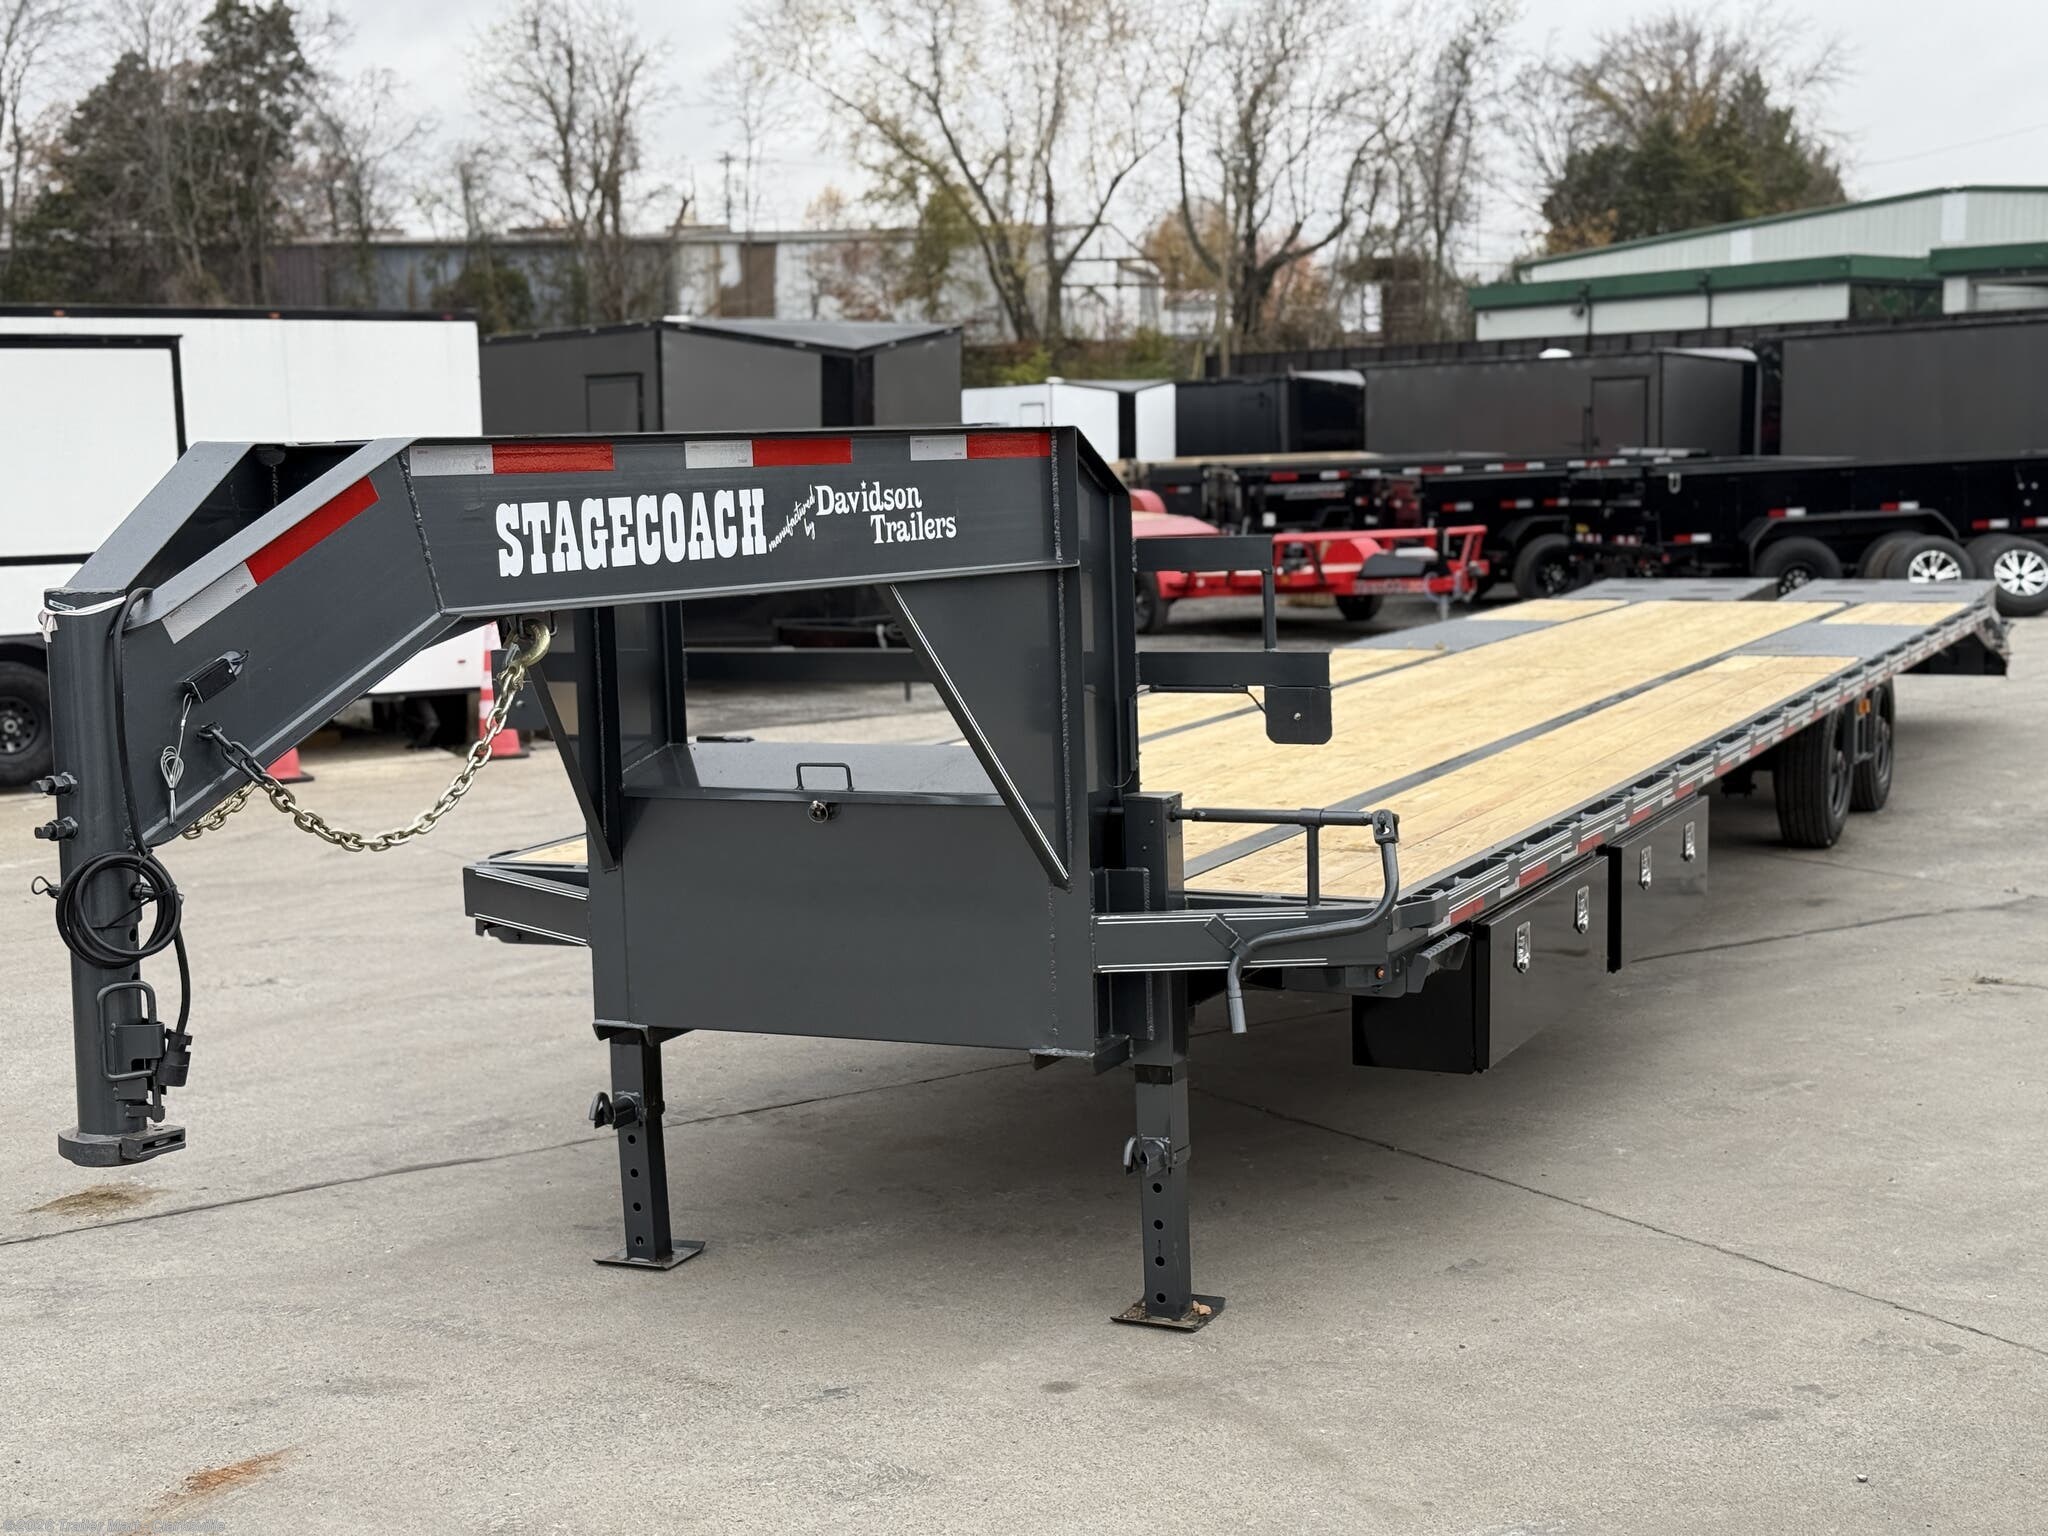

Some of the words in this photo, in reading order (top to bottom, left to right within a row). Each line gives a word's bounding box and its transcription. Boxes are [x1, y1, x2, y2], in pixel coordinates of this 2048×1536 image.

[815, 480, 923, 516] Davidson
[496, 488, 767, 577] STAGECOACH
[768, 484, 816, 552] manufactured
[804, 518, 816, 540] by
[870, 511, 957, 544] Trailers
